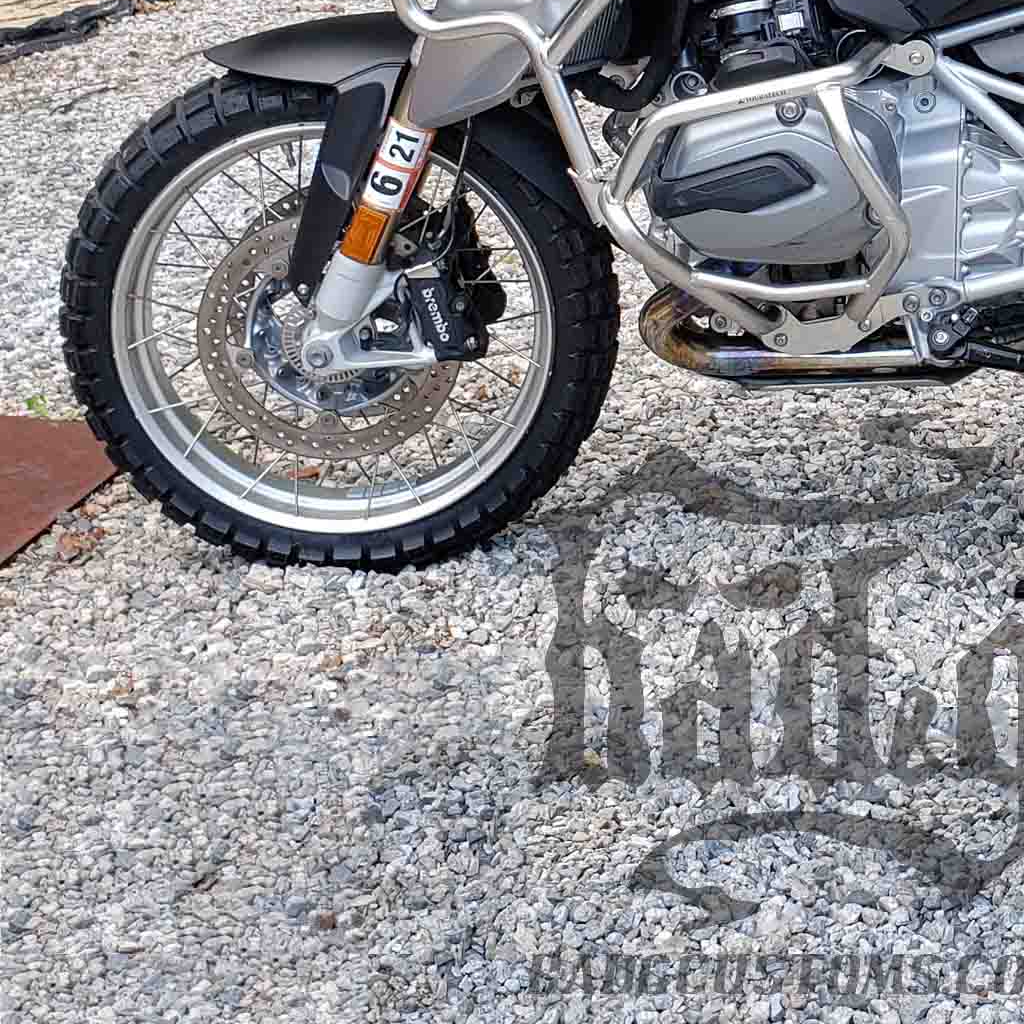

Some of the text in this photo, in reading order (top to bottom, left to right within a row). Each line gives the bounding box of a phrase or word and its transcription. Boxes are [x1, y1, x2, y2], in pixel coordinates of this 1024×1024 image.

[369, 129, 421, 197] 6 21
[421, 286, 451, 344] brembo
